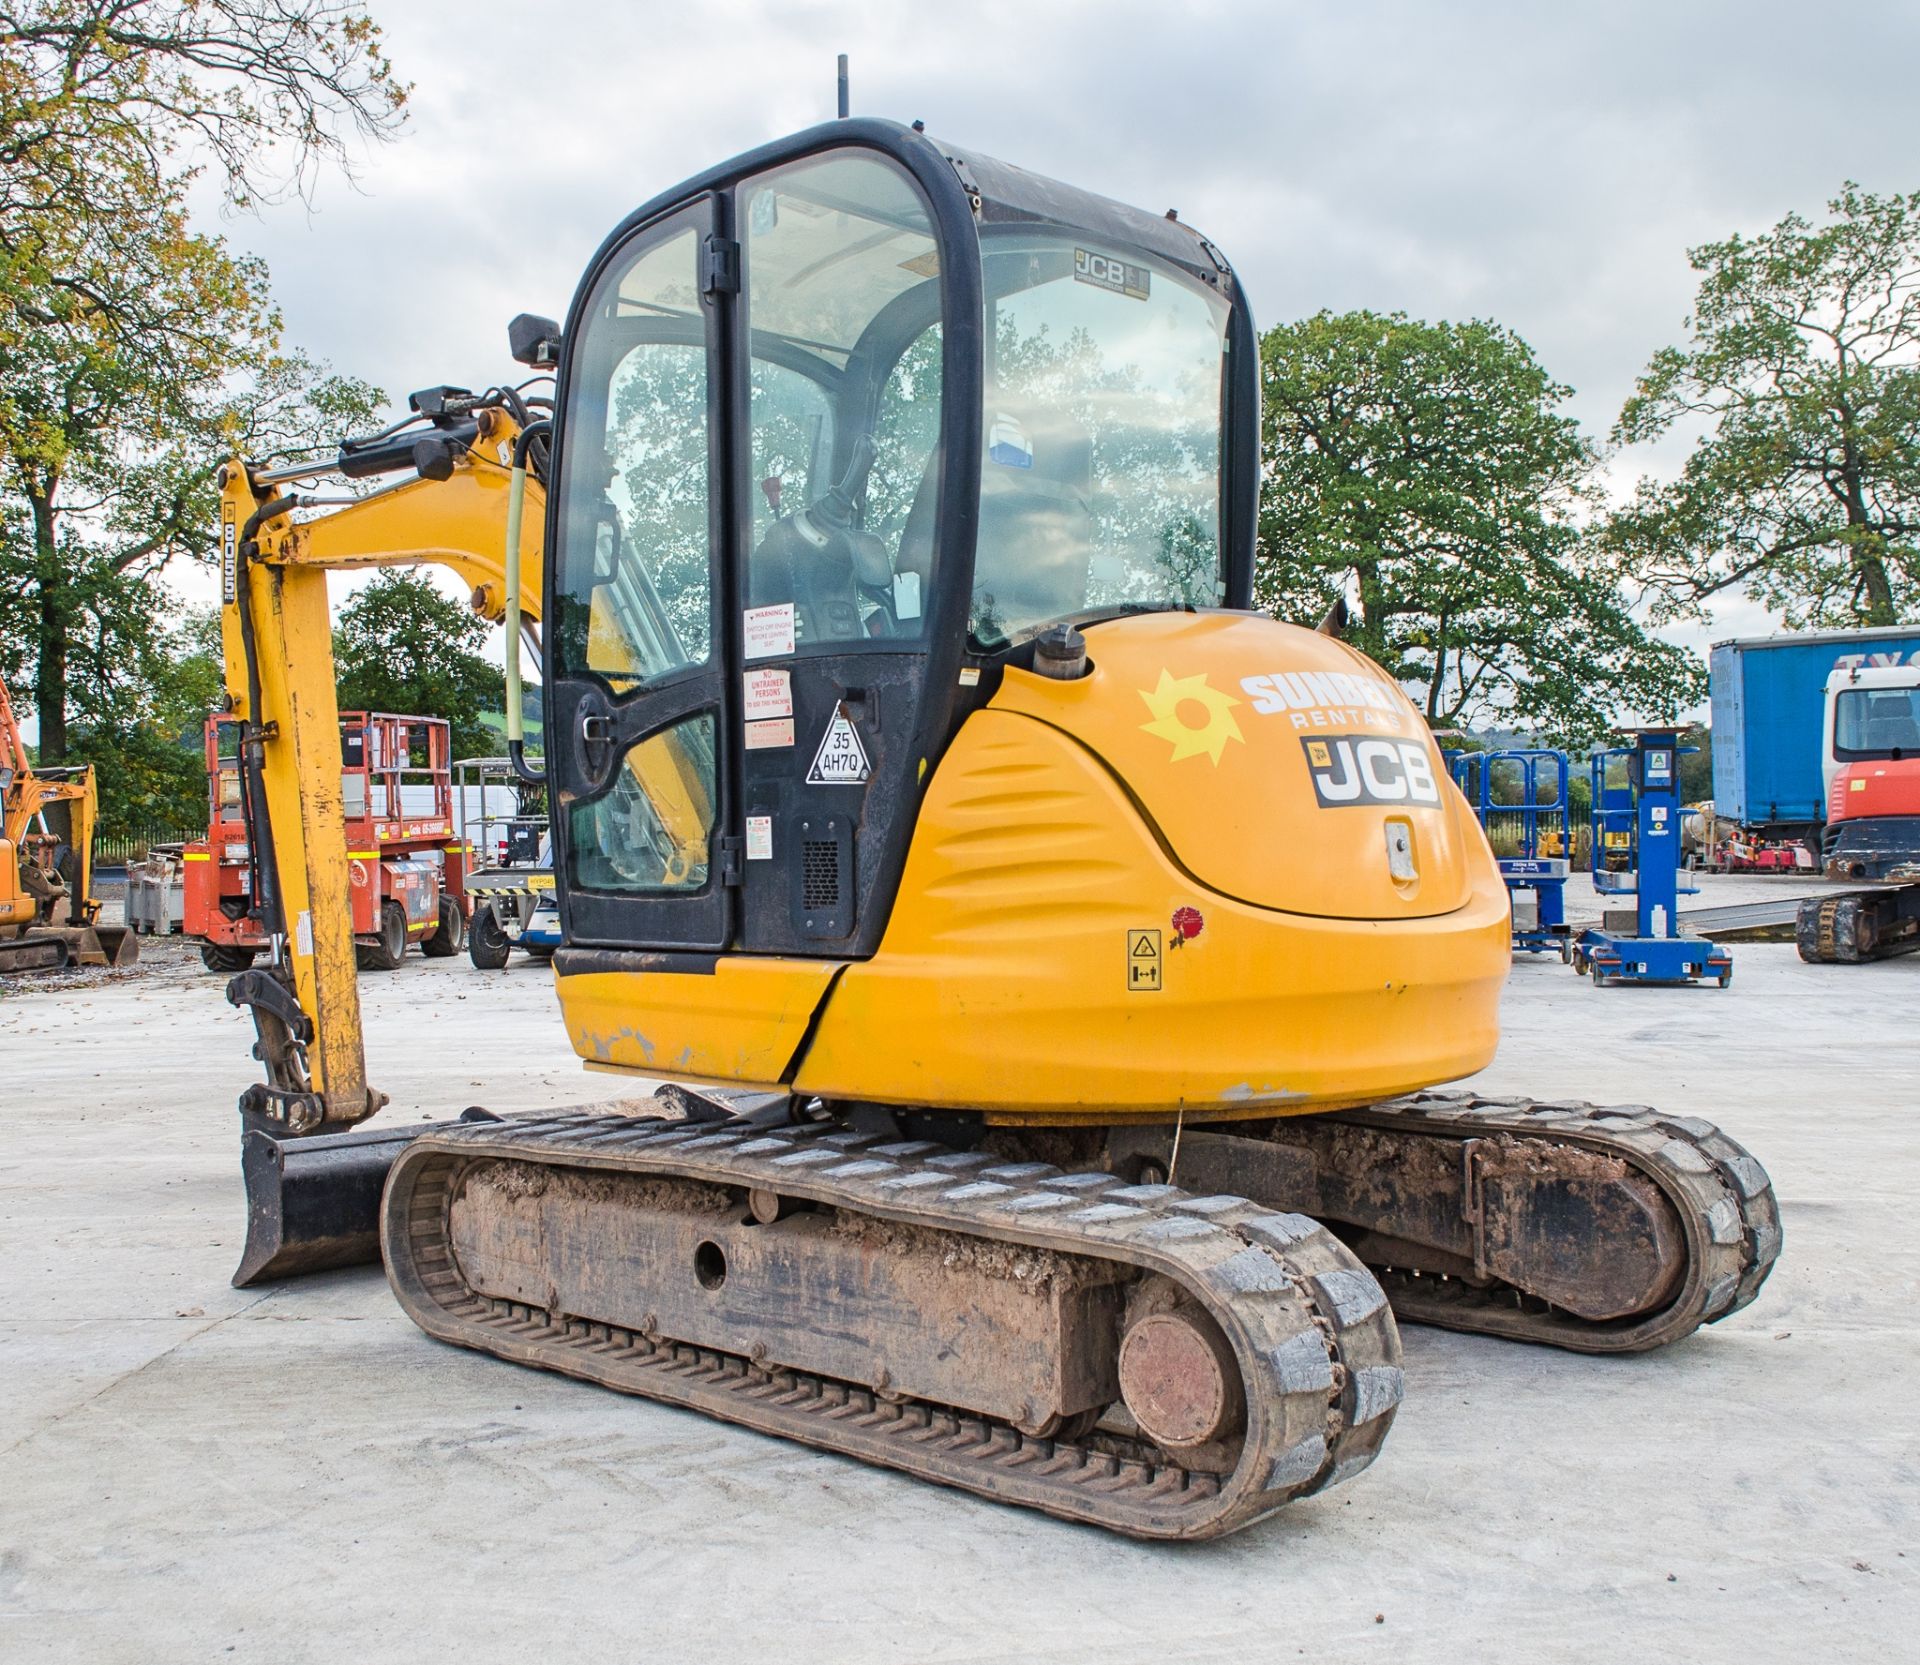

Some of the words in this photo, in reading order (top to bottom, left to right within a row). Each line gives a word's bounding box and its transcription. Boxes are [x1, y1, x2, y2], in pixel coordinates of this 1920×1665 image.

[1075, 252, 1125, 284] JCB
[224, 524, 235, 593] 8055
[755, 609, 783, 618] WARNING
[763, 670, 772, 679] NO
[751, 679, 785, 690] UNTRAINED
[755, 688, 781, 698] PERSONS
[834, 733, 849, 749] 35
[824, 754, 858, 771] AH7Q
[1316, 740, 1438, 802] JCB
